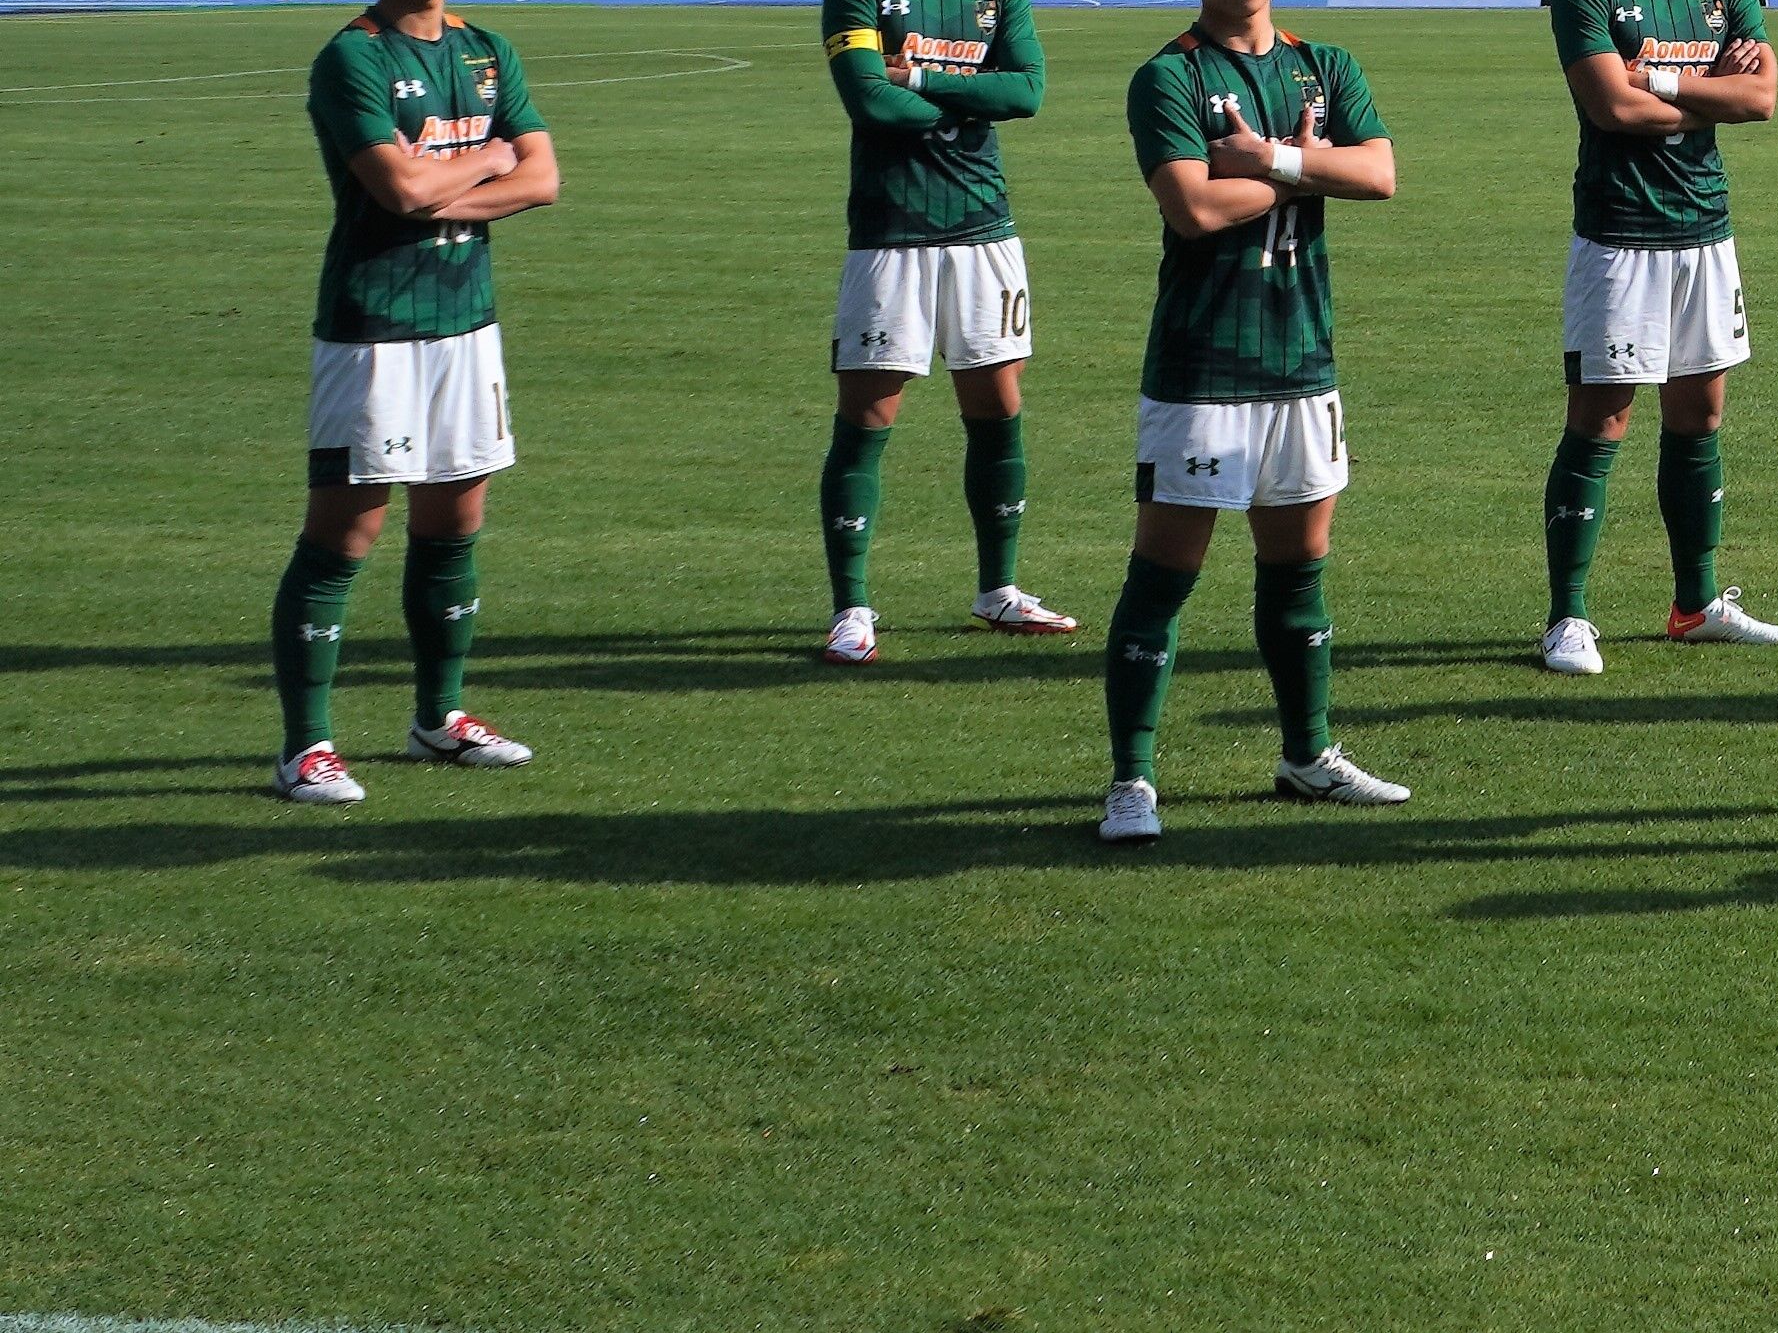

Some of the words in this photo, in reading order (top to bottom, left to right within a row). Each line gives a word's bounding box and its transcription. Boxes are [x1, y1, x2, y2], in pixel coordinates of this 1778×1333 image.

[902, 32, 989, 64] AOMORI
[1637, 37, 1721, 63] AOMORI
[1000, 288, 1027, 338] 10
